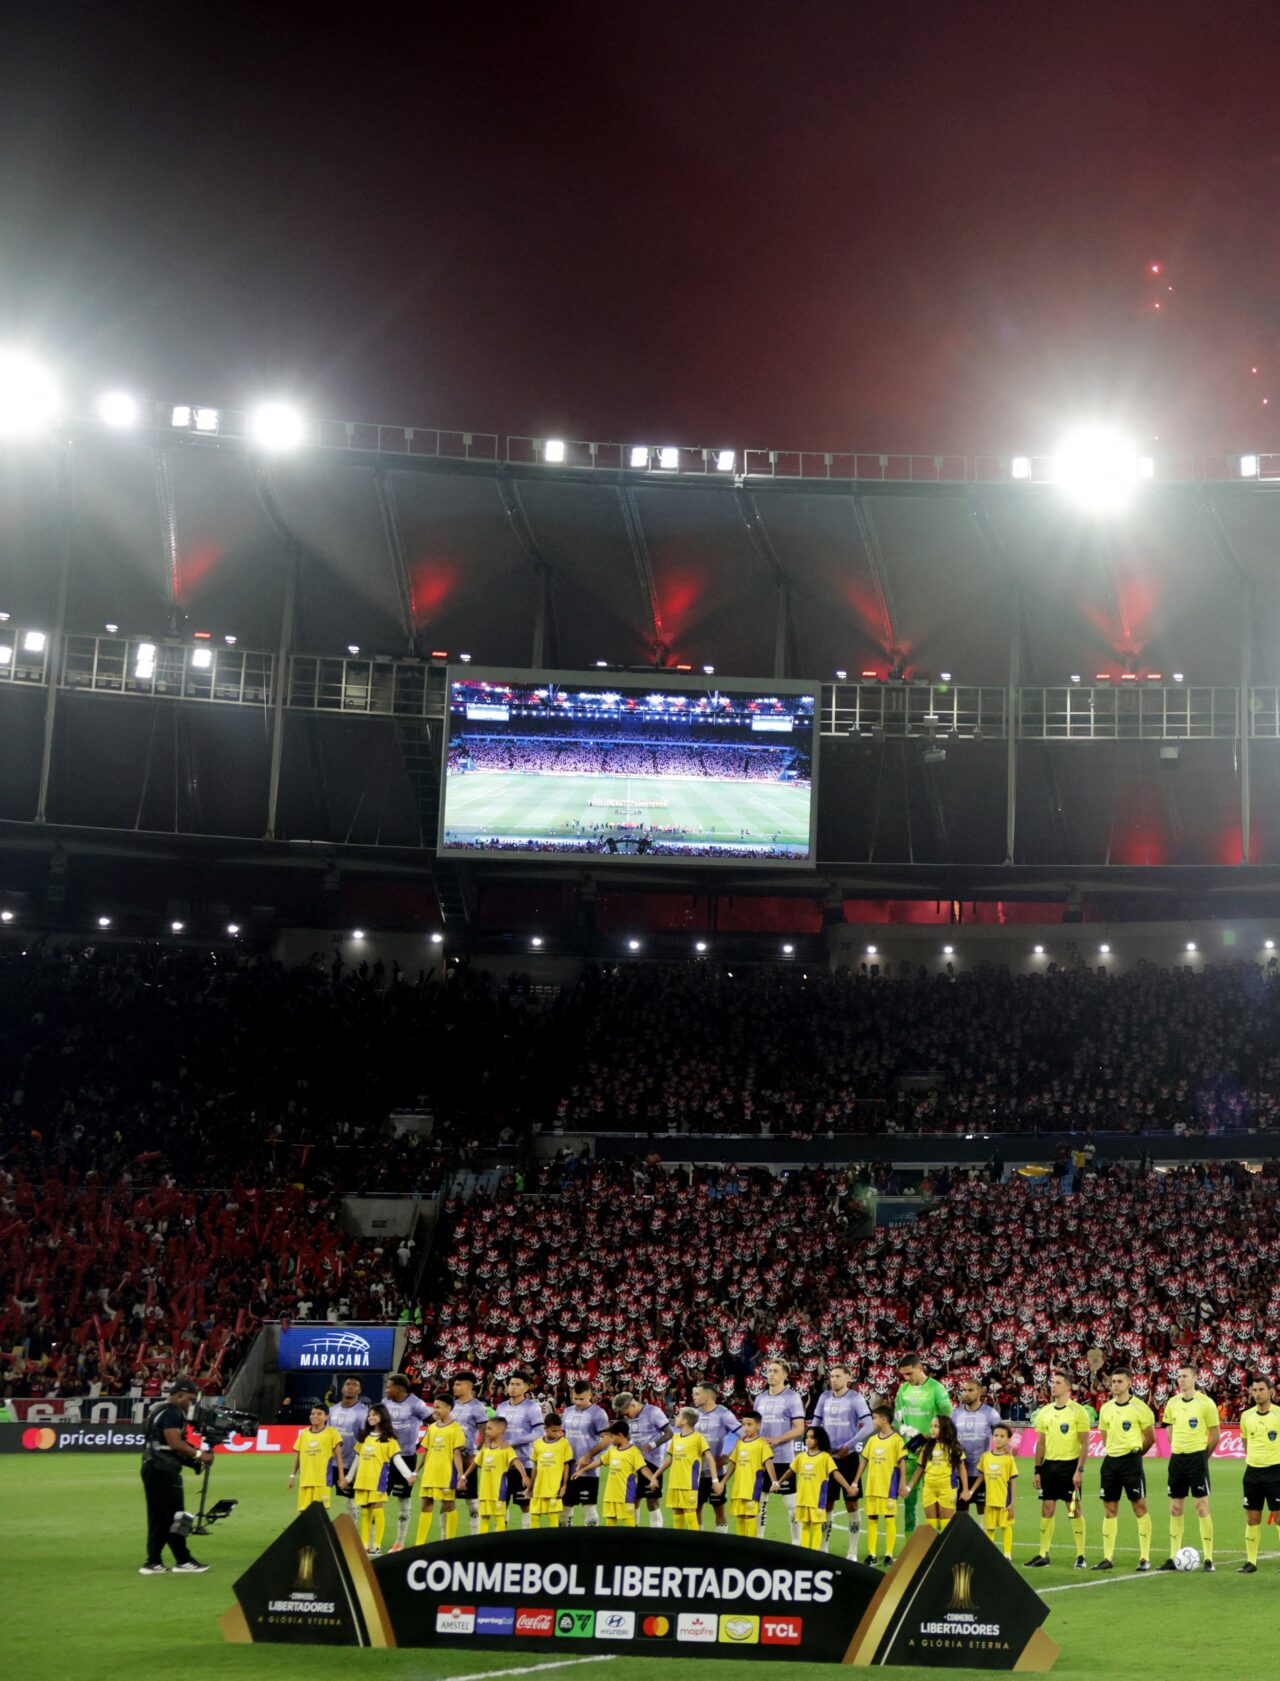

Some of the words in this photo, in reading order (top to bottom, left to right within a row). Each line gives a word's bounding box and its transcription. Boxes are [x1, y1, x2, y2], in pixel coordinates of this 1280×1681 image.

[300, 1352, 369, 1366] MARACANÃ
[59, 1429, 145, 1448] priceless
[406, 1559, 585, 1595] CONMEBOL
[594, 1565, 833, 1602] LIBERTADORES
[268, 1600, 335, 1613] LIBERTADORES
[947, 1613, 974, 1622] CONMEBOL
[441, 1621, 469, 1631] AMSTEL
[680, 1627, 714, 1637] mapfre
[764, 1623, 798, 1638] TCL
[920, 1622, 1000, 1636] LIBERTADORES
[922, 1639, 962, 1648] GLÓRIA
[969, 1641, 1009, 1649] ETERNA
